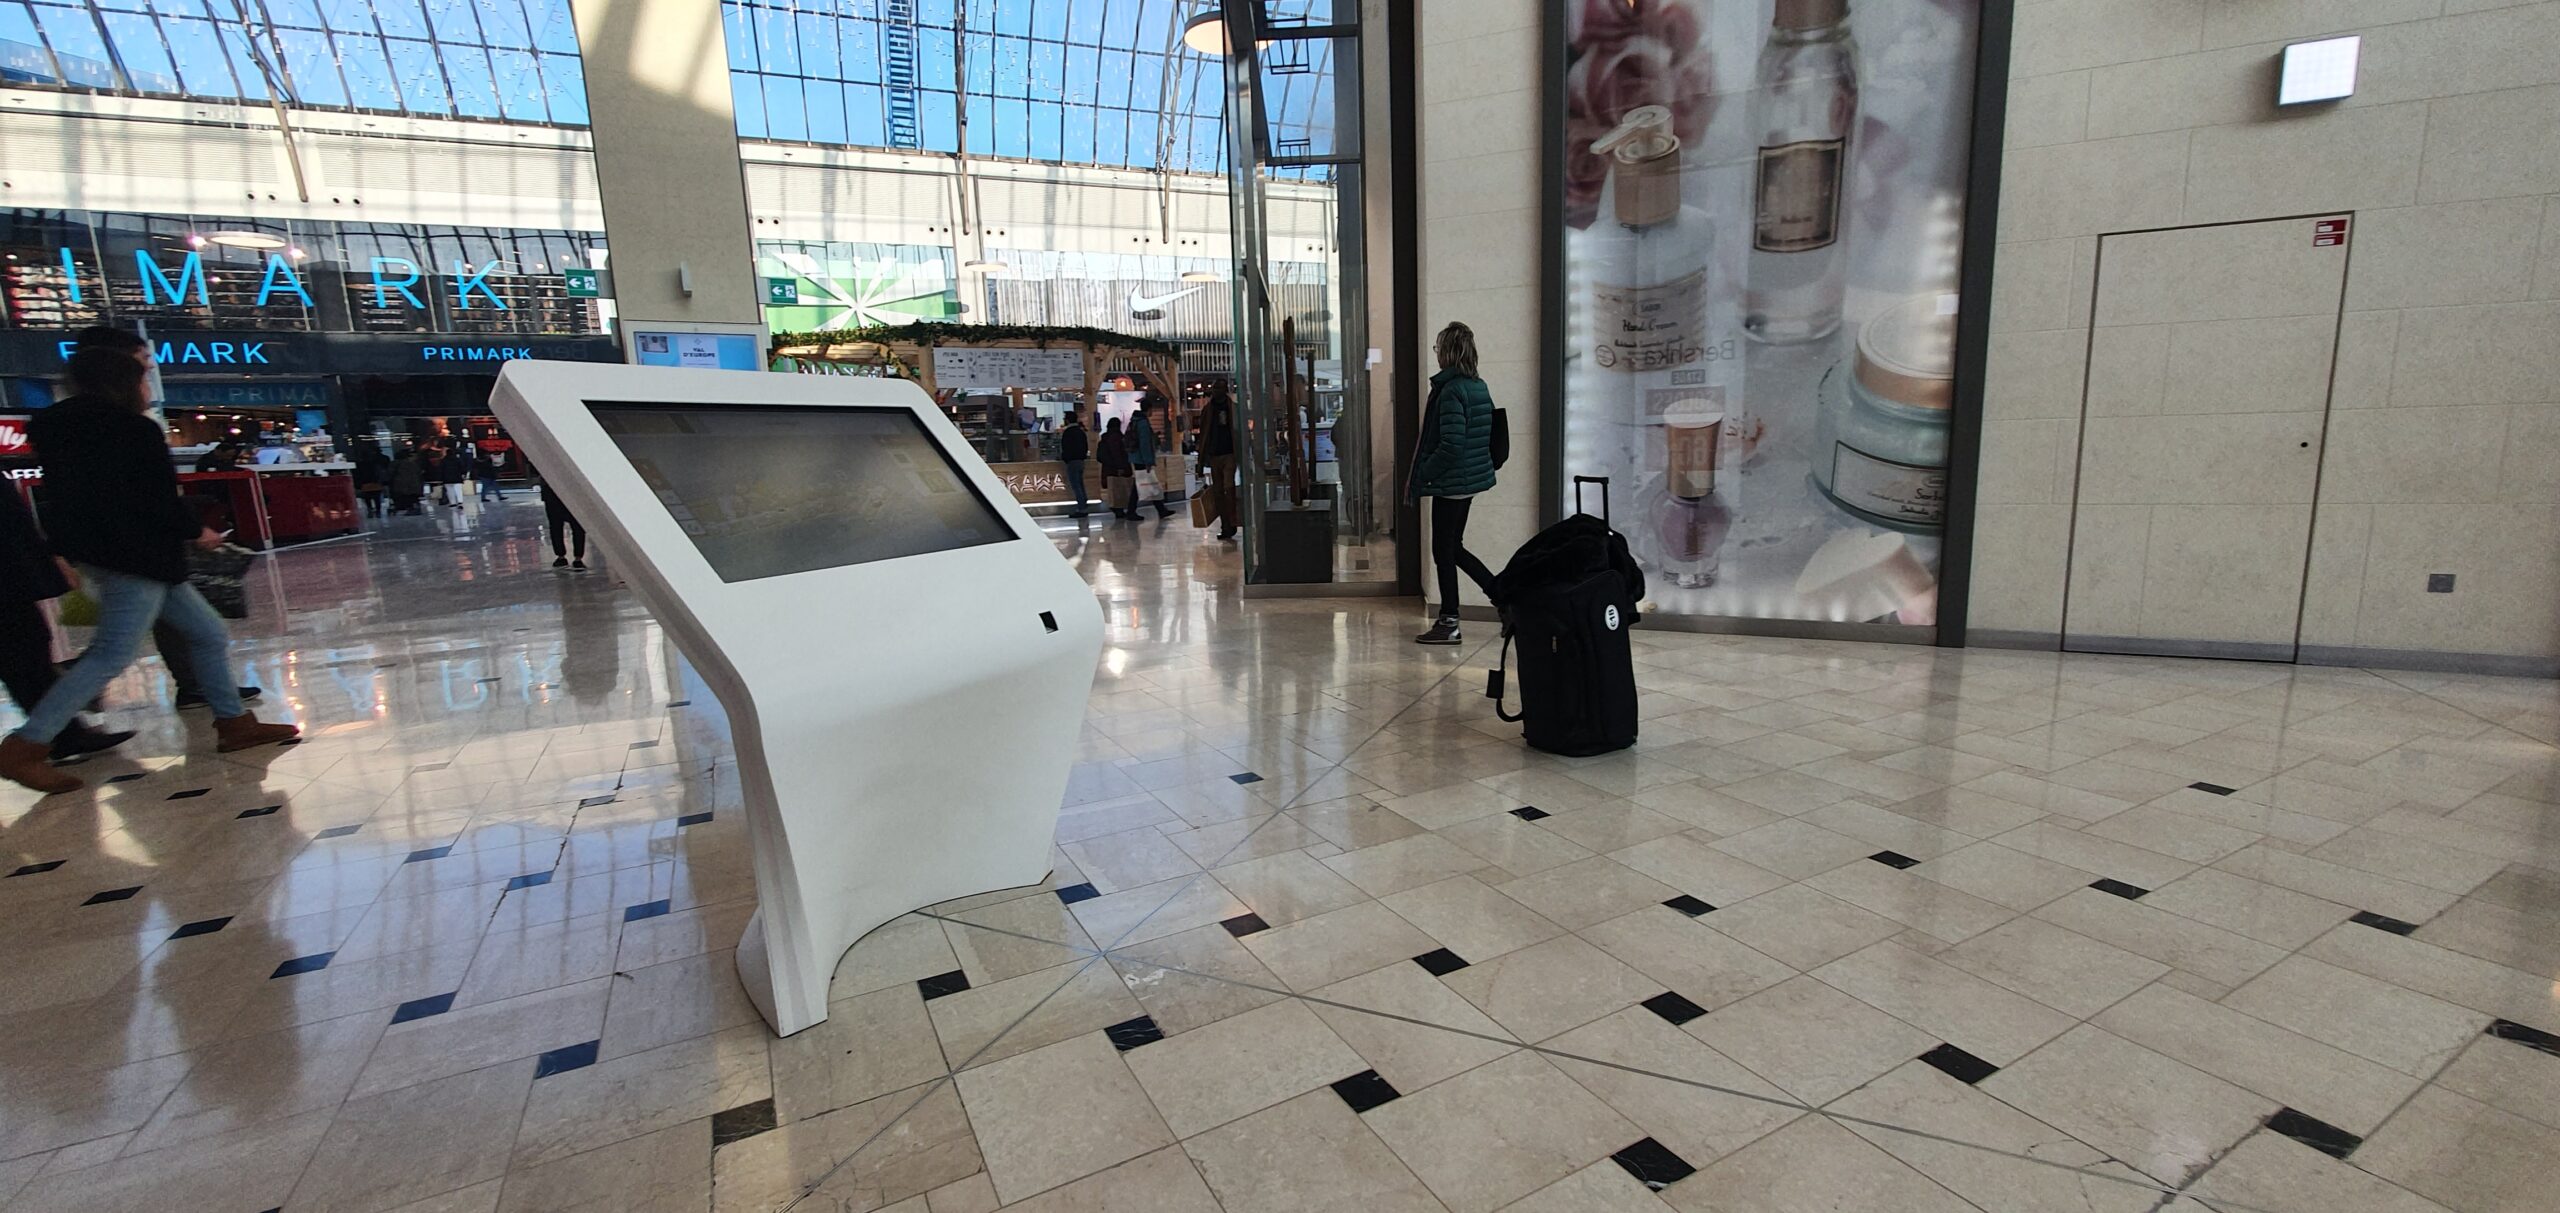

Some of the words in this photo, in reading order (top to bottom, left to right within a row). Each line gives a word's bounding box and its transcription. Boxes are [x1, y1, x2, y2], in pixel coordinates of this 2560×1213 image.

[60, 247, 509, 310] IMARK
[58, 341, 269, 364] PMARK
[423, 347, 532, 361] PRIMARK
